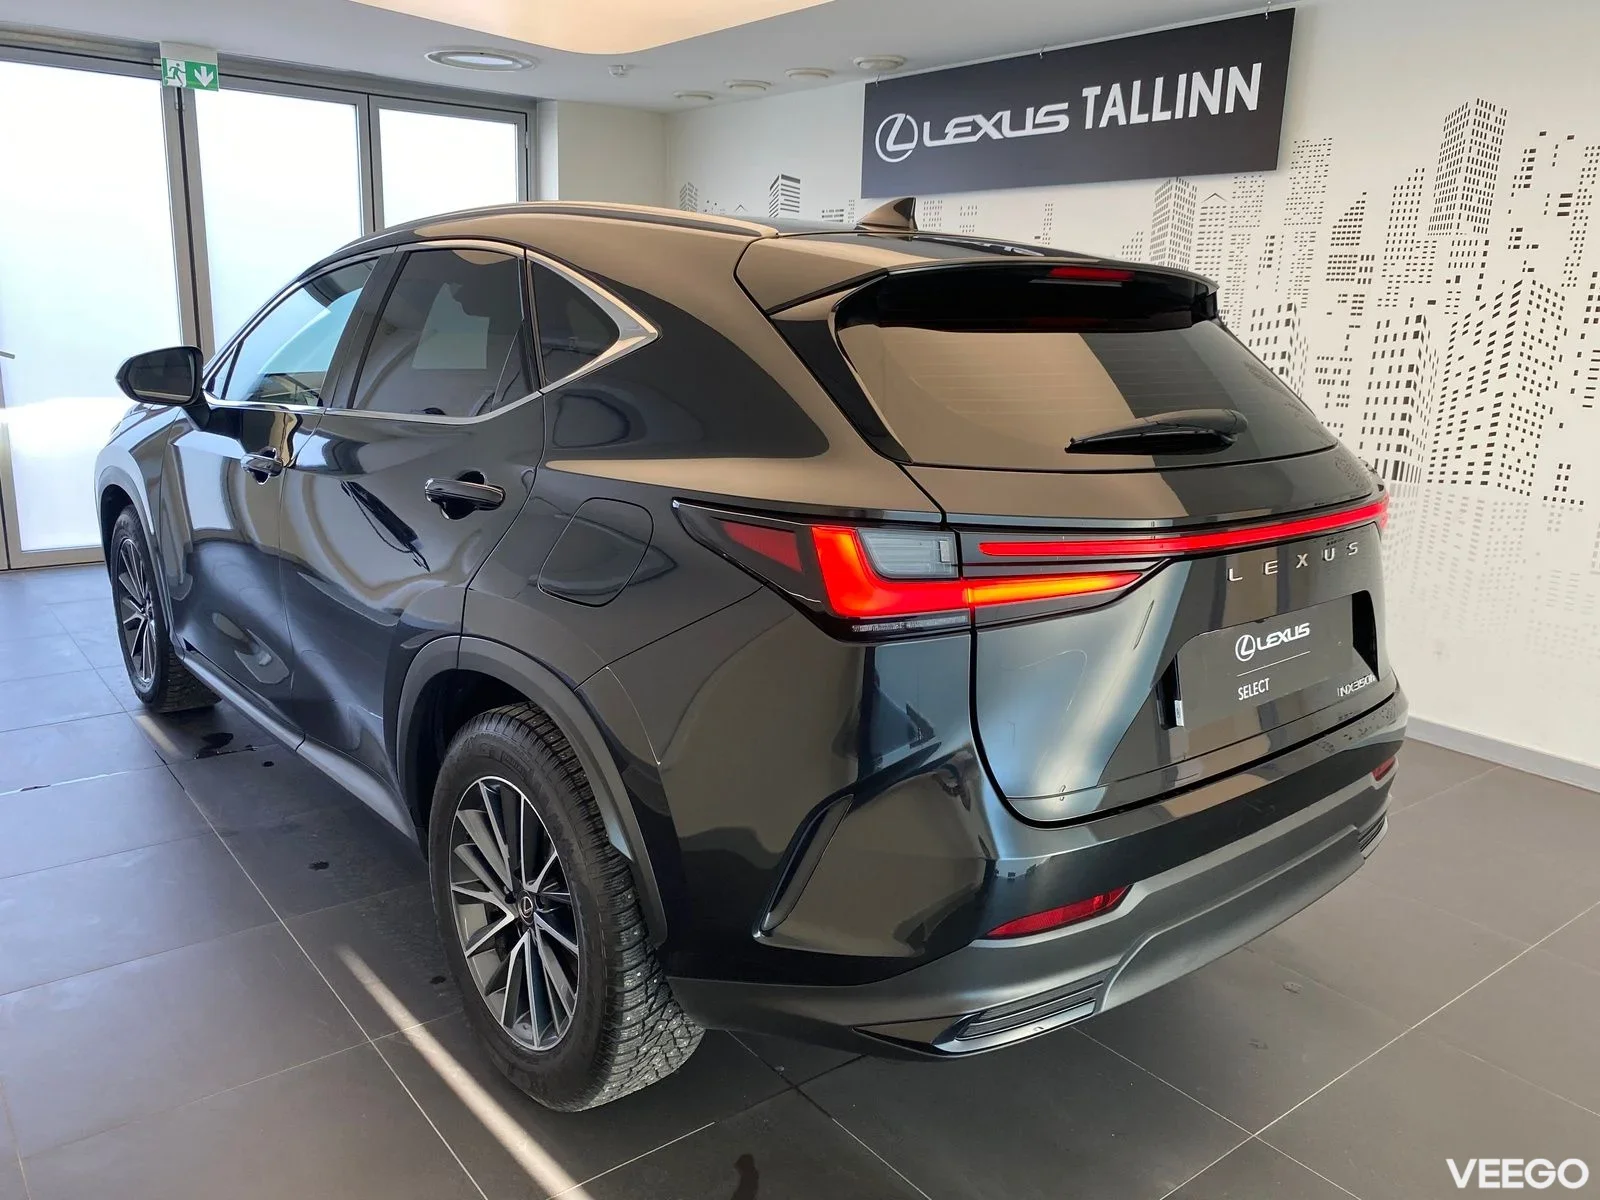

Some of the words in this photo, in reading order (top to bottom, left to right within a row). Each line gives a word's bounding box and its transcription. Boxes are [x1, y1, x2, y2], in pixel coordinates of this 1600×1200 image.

[922, 102, 1070, 147] LEXUS
[1082, 62, 1262, 130] TALLINN
[1228, 541, 1358, 582] LEXUS
[1256, 622, 1311, 650] LEXUS
[1237, 677, 1270, 701] SELECT
